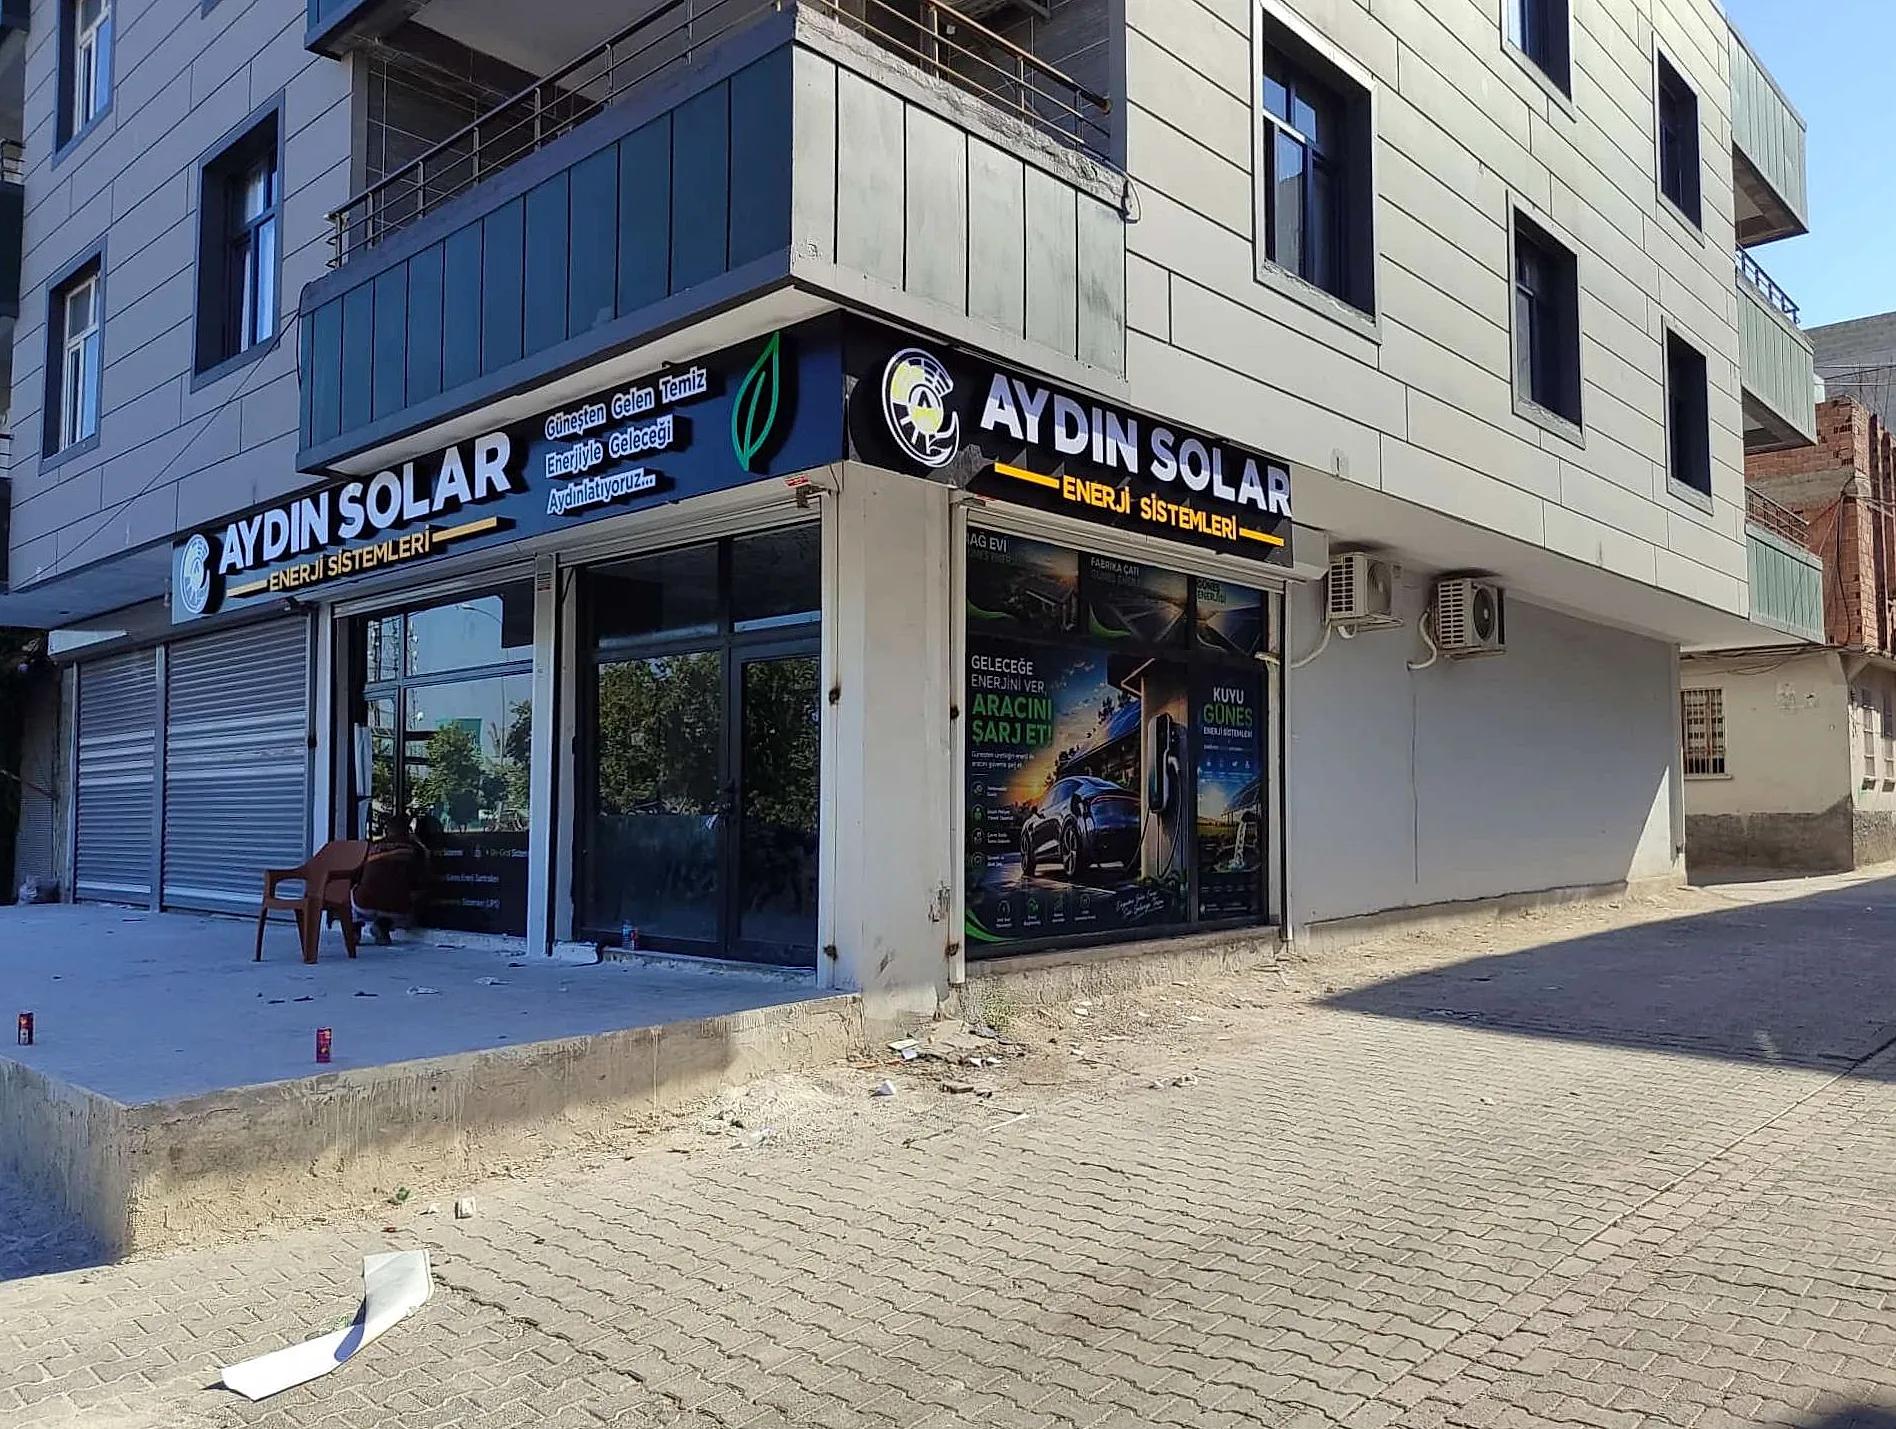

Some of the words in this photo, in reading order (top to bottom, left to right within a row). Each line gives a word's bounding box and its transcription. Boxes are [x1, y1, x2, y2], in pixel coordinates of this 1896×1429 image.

[545, 402, 607, 440] Güneşten
[611, 387, 655, 419] Gelen
[659, 366, 707, 404] Temiz
[545, 439, 603, 478] Enerjiyle
[609, 413, 674, 458] Geleceği
[980, 373, 1139, 474] AYDIN
[1150, 427, 1292, 518] SOLAR
[218, 491, 329, 575] AYDIN
[338, 432, 512, 540] SOLAR
[1062, 474, 1131, 515] ENERJİ
[1140, 492, 1238, 541] SİSTEMLERİ
[269, 560, 325, 592] ENERJİ
[327, 527, 431, 577] SİSTEMLERİ
[971, 654, 1034, 676] GELECEĞE
[971, 673, 1021, 692] ENERJİNİ
[1213, 686, 1244, 705] KUYU
[972, 693, 1052, 720] ARACINI
[972, 719, 1021, 745] ŞARJ
